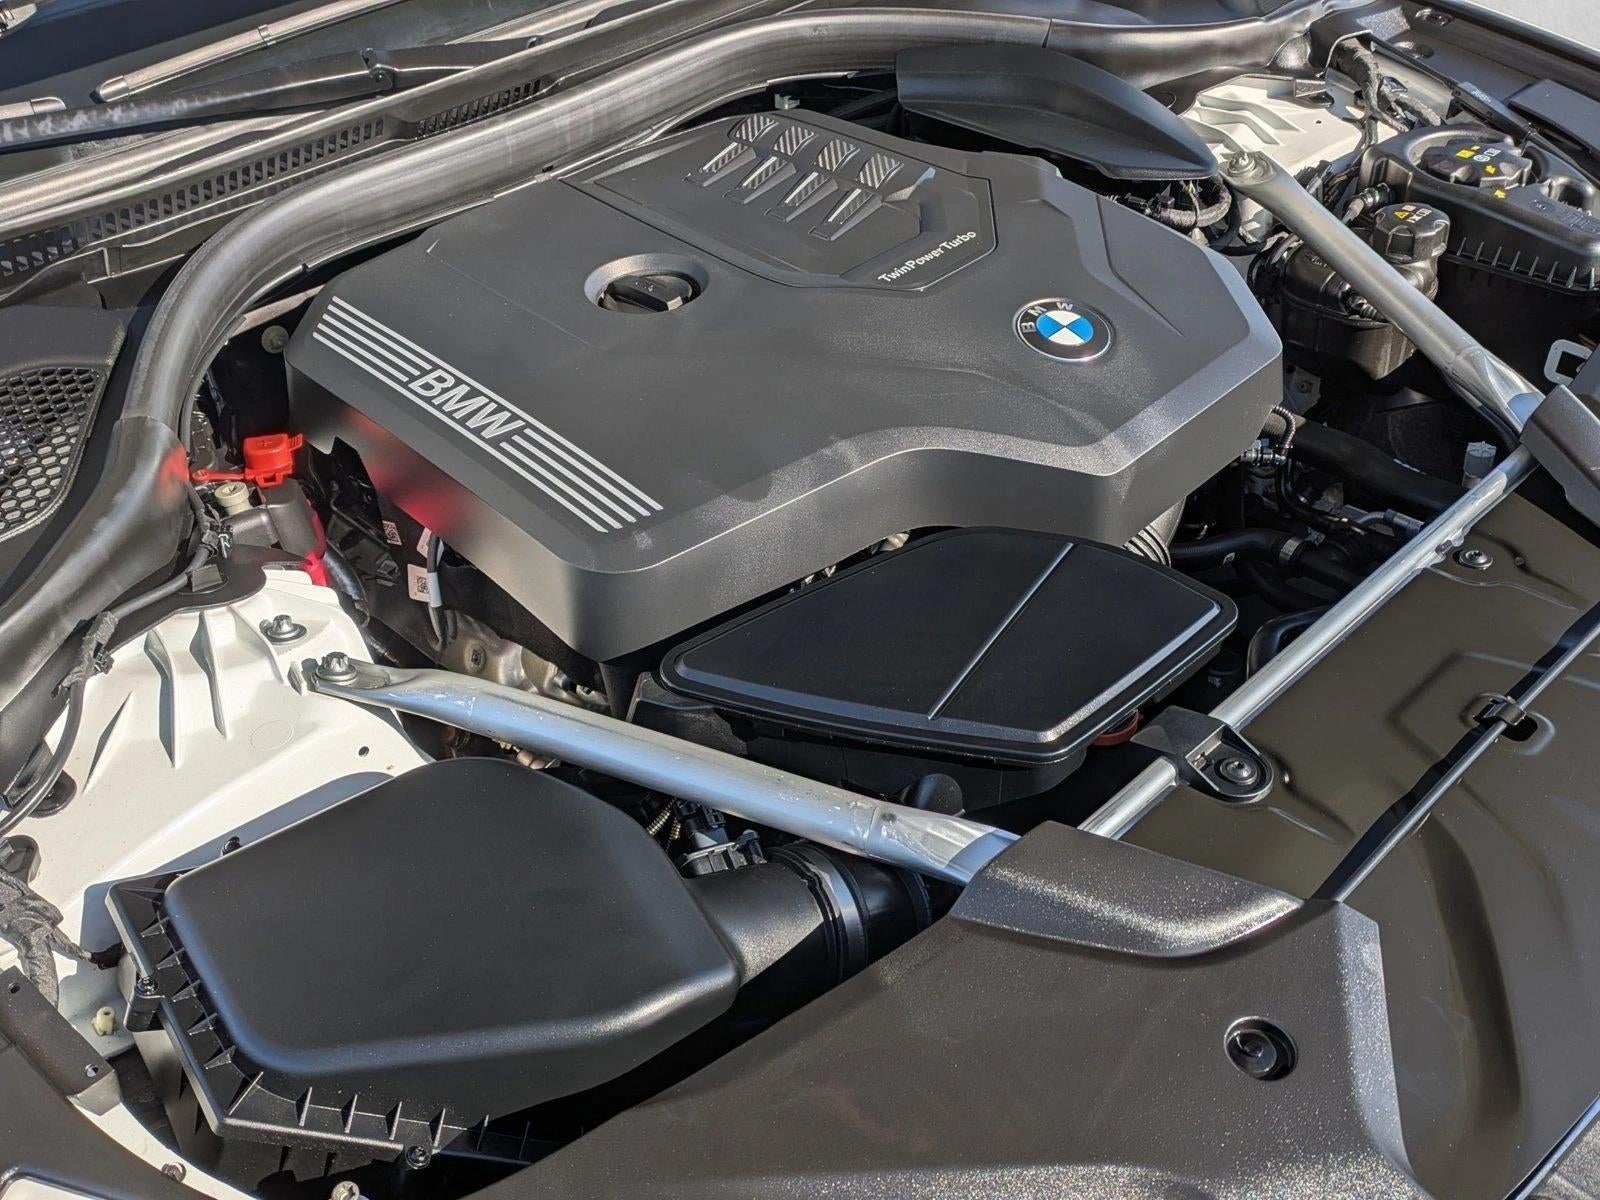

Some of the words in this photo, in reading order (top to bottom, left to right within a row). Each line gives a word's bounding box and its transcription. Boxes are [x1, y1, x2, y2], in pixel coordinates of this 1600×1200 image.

[877, 231, 977, 283] TwinPowerTurbo
[1021, 301, 1075, 333] BMW
[407, 368, 526, 440] BMW
